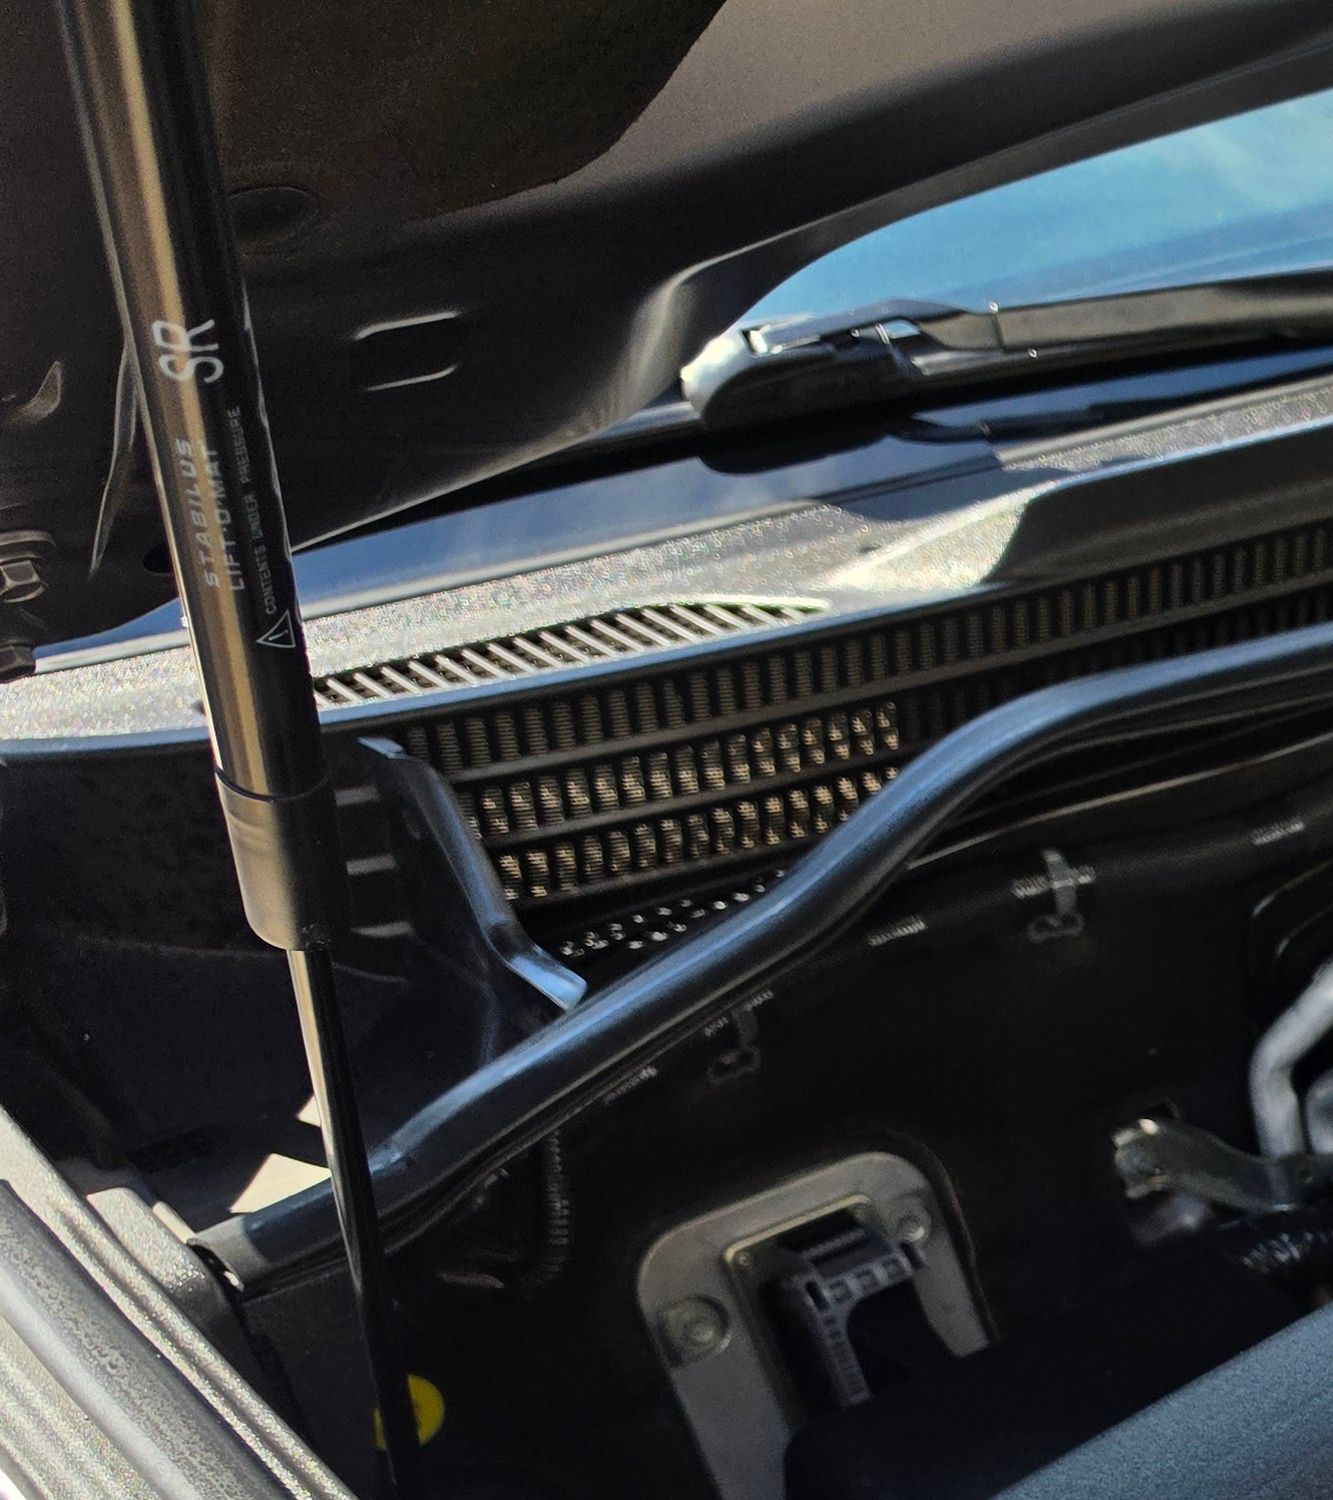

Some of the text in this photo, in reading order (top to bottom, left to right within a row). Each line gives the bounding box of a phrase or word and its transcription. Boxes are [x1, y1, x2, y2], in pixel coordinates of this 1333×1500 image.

[152, 319, 224, 383] SR
[175, 438, 221, 589] STABILUS
[228, 406, 278, 614] CONTENTS UNDER PRESSURE
